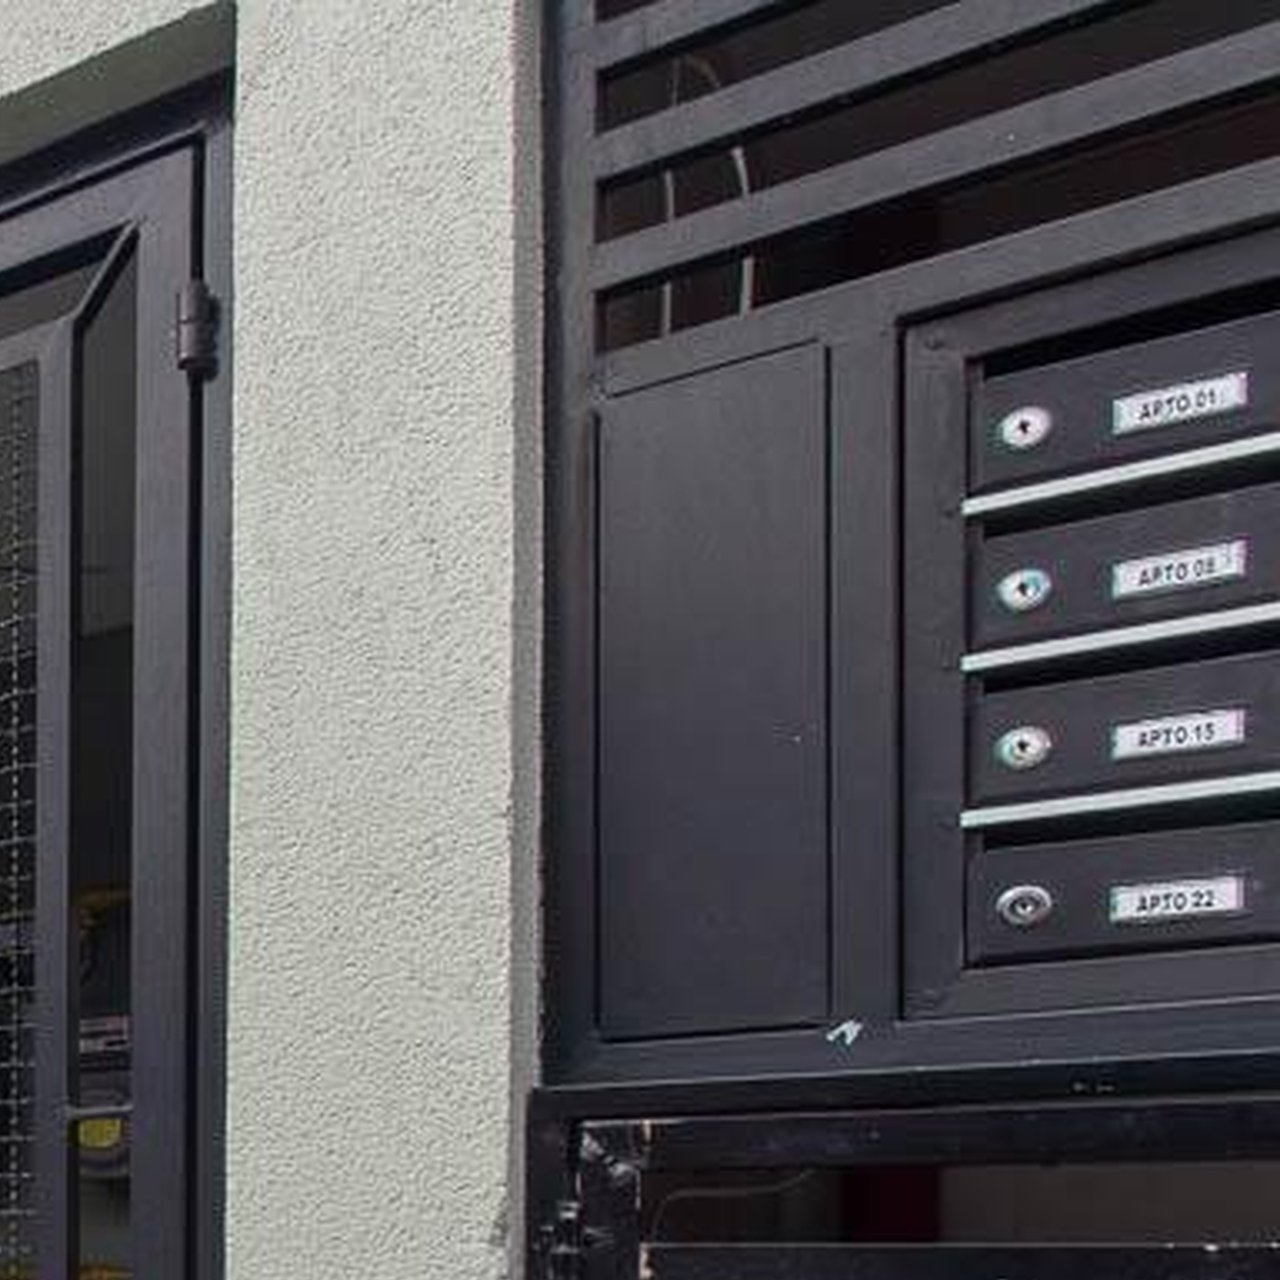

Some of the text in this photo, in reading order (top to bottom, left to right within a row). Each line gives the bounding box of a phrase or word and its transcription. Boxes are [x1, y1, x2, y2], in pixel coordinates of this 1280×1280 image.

[1138, 388, 1216, 421] APTO 01
[1138, 563, 1188, 587] APTO
[1138, 722, 1215, 747] APTO 15
[1136, 889, 1215, 912] APTO 22
